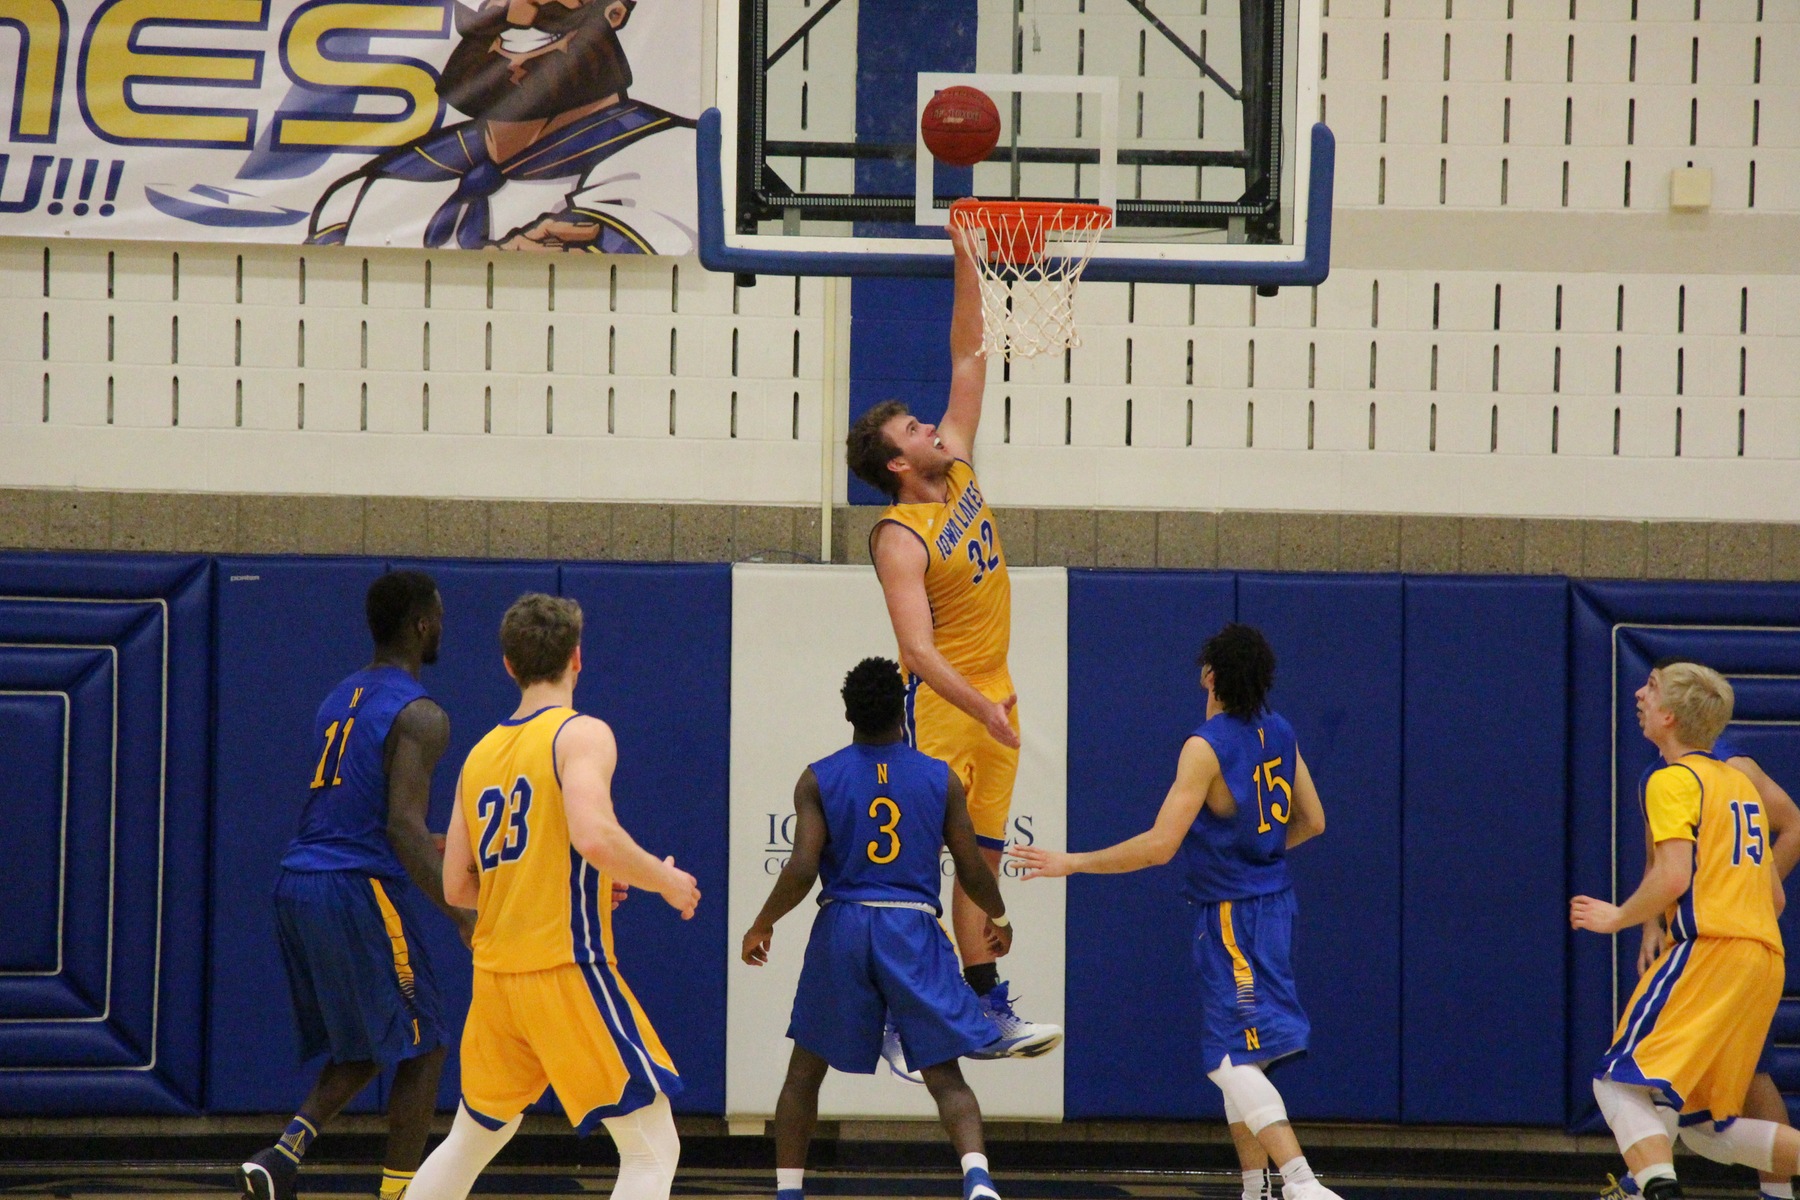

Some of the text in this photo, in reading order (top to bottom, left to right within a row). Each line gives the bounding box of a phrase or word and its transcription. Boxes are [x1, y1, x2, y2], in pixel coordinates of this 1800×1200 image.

[935, 517, 964, 561] IOWA
[966, 518, 999, 584] 32
[309, 716, 355, 789] 11
[876, 763, 888, 784] N
[476, 774, 533, 872] 23
[1252, 756, 1293, 834] 15
[867, 796, 901, 864] 3
[1730, 800, 1765, 867] 15
[1243, 1026, 1261, 1051] N
